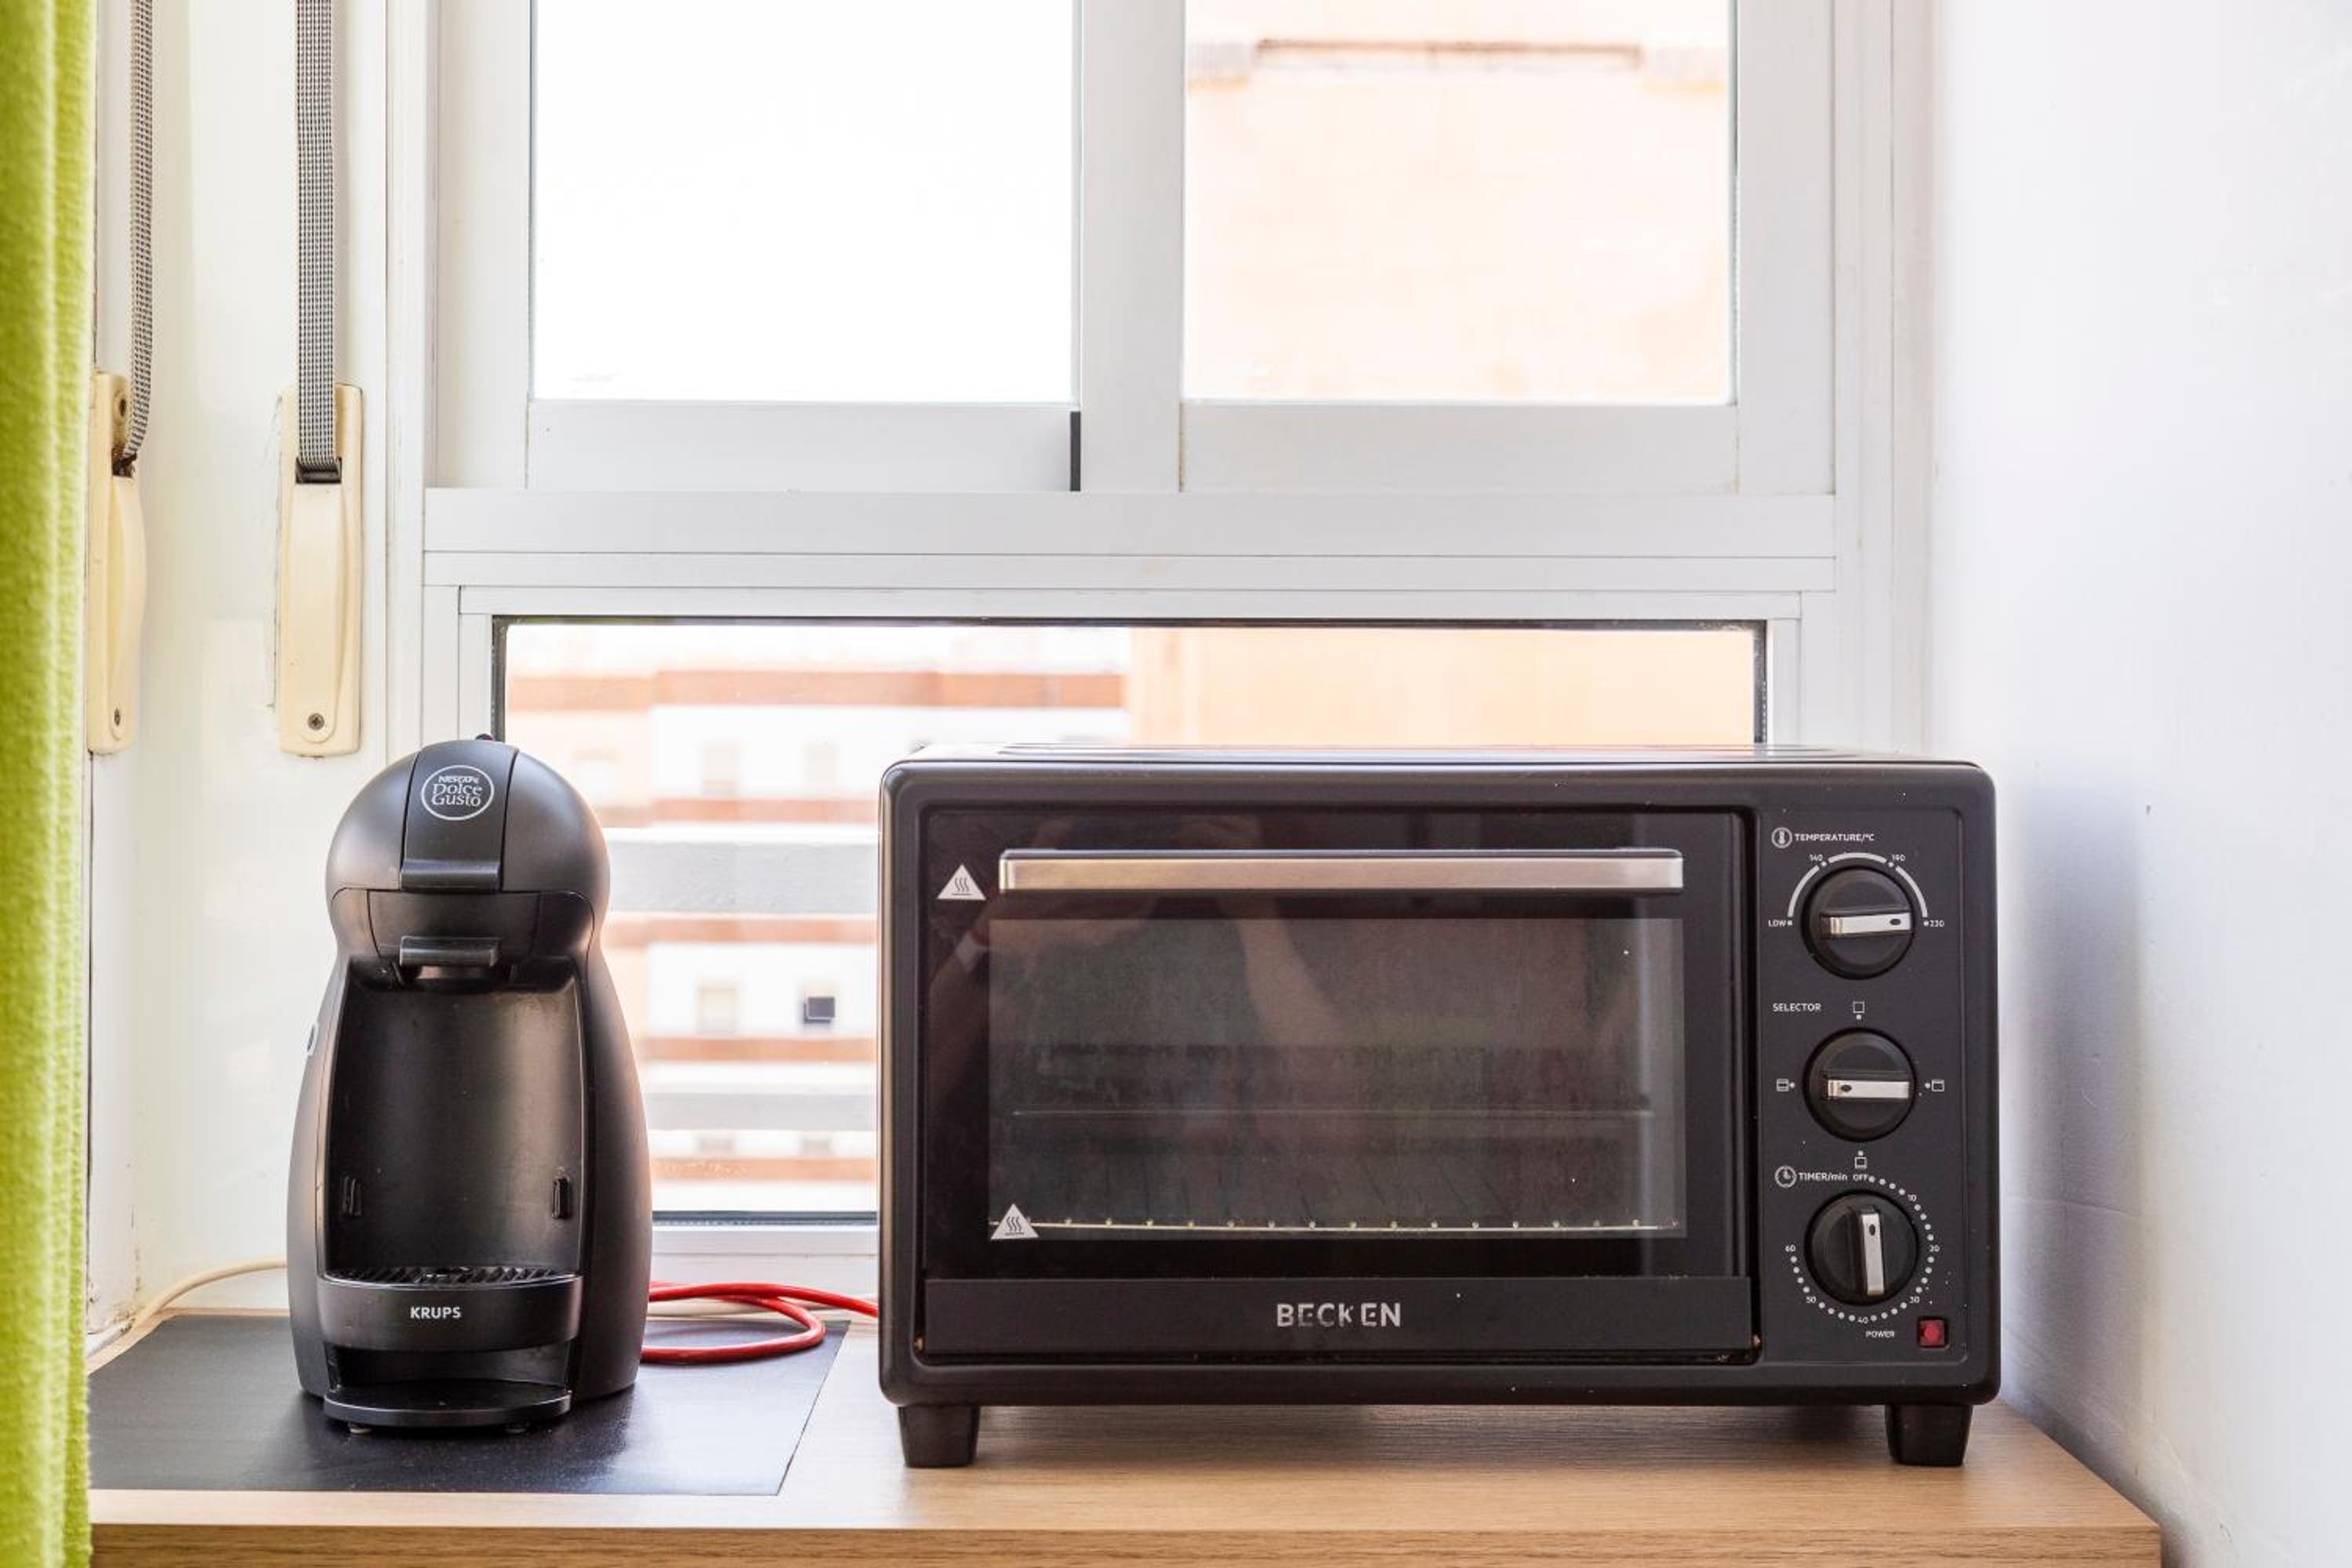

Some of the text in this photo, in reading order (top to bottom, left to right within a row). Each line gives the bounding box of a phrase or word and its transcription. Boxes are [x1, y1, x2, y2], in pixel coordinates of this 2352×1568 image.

[433, 783, 483, 795] Dolce
[431, 793, 481, 806] Gusto
[1773, 1003, 1821, 1012] SELECTOR
[1798, 1173, 1848, 1181] TIMER/min
[410, 1306, 461, 1319] KRUPS
[1277, 1302, 1401, 1327] BECKEN
